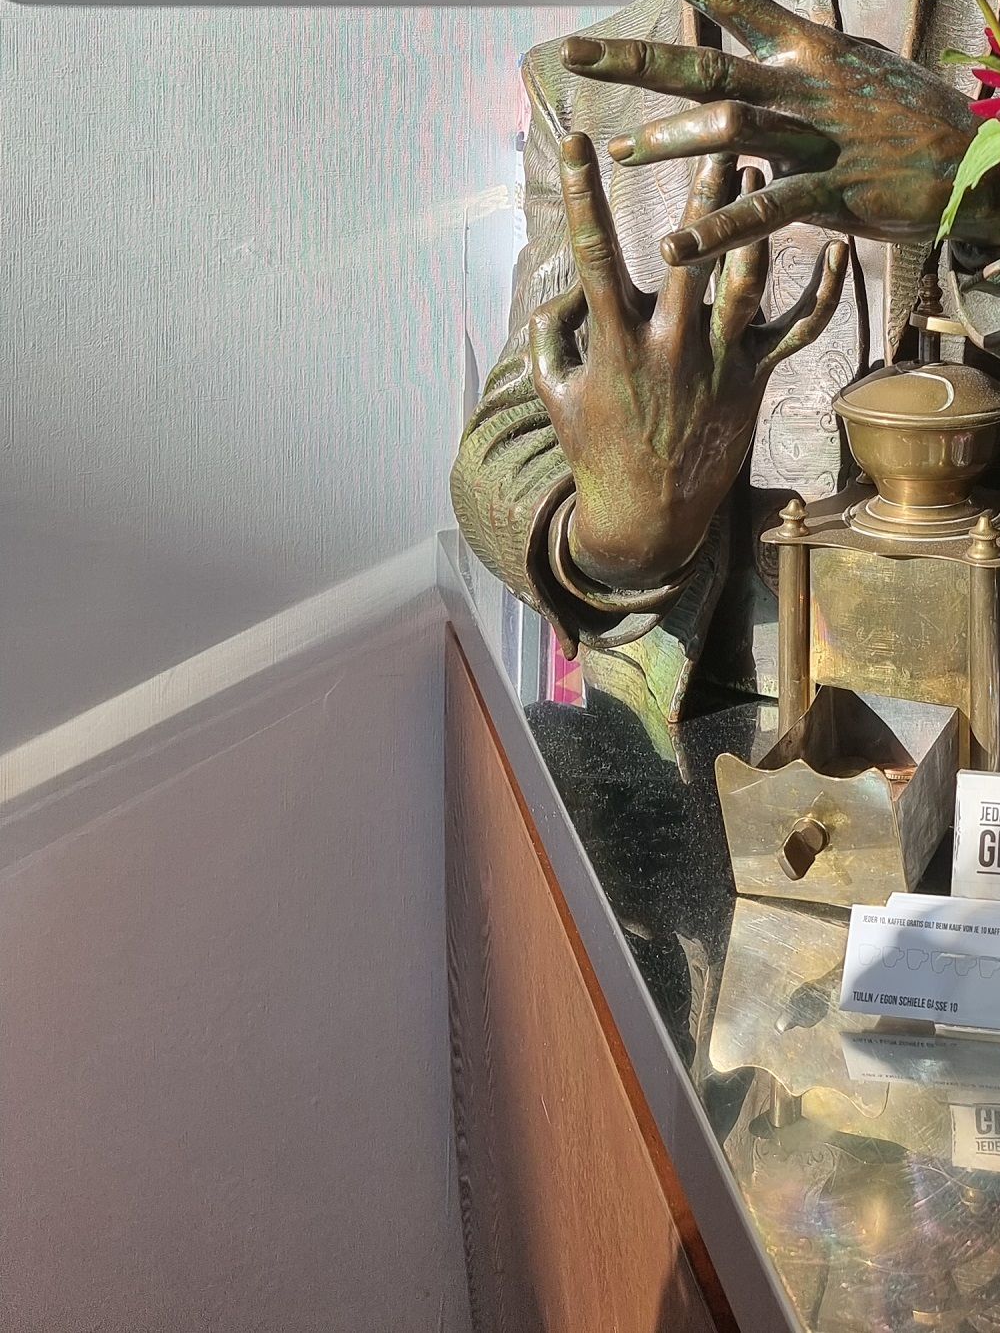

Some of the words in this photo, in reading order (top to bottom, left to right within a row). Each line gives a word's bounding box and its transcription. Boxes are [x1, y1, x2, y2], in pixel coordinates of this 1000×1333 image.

[862, 914, 878, 924] JEDER
[887, 916, 906, 927] KAFFEE
[906, 918, 924, 928] GRATIS
[924, 920, 935, 929] GILT
[935, 922, 948, 931] BEIM
[948, 923, 962, 932] KAUF
[962, 924, 973, 933] VON
[973, 926, 980, 934] JE
[980, 926, 987, 935] 10
[853, 991, 874, 1003] TULLN
[880, 994, 898, 1006] EGON
[898, 996, 926, 1009] SCHIELE
[950, 1002, 959, 1013] 10
